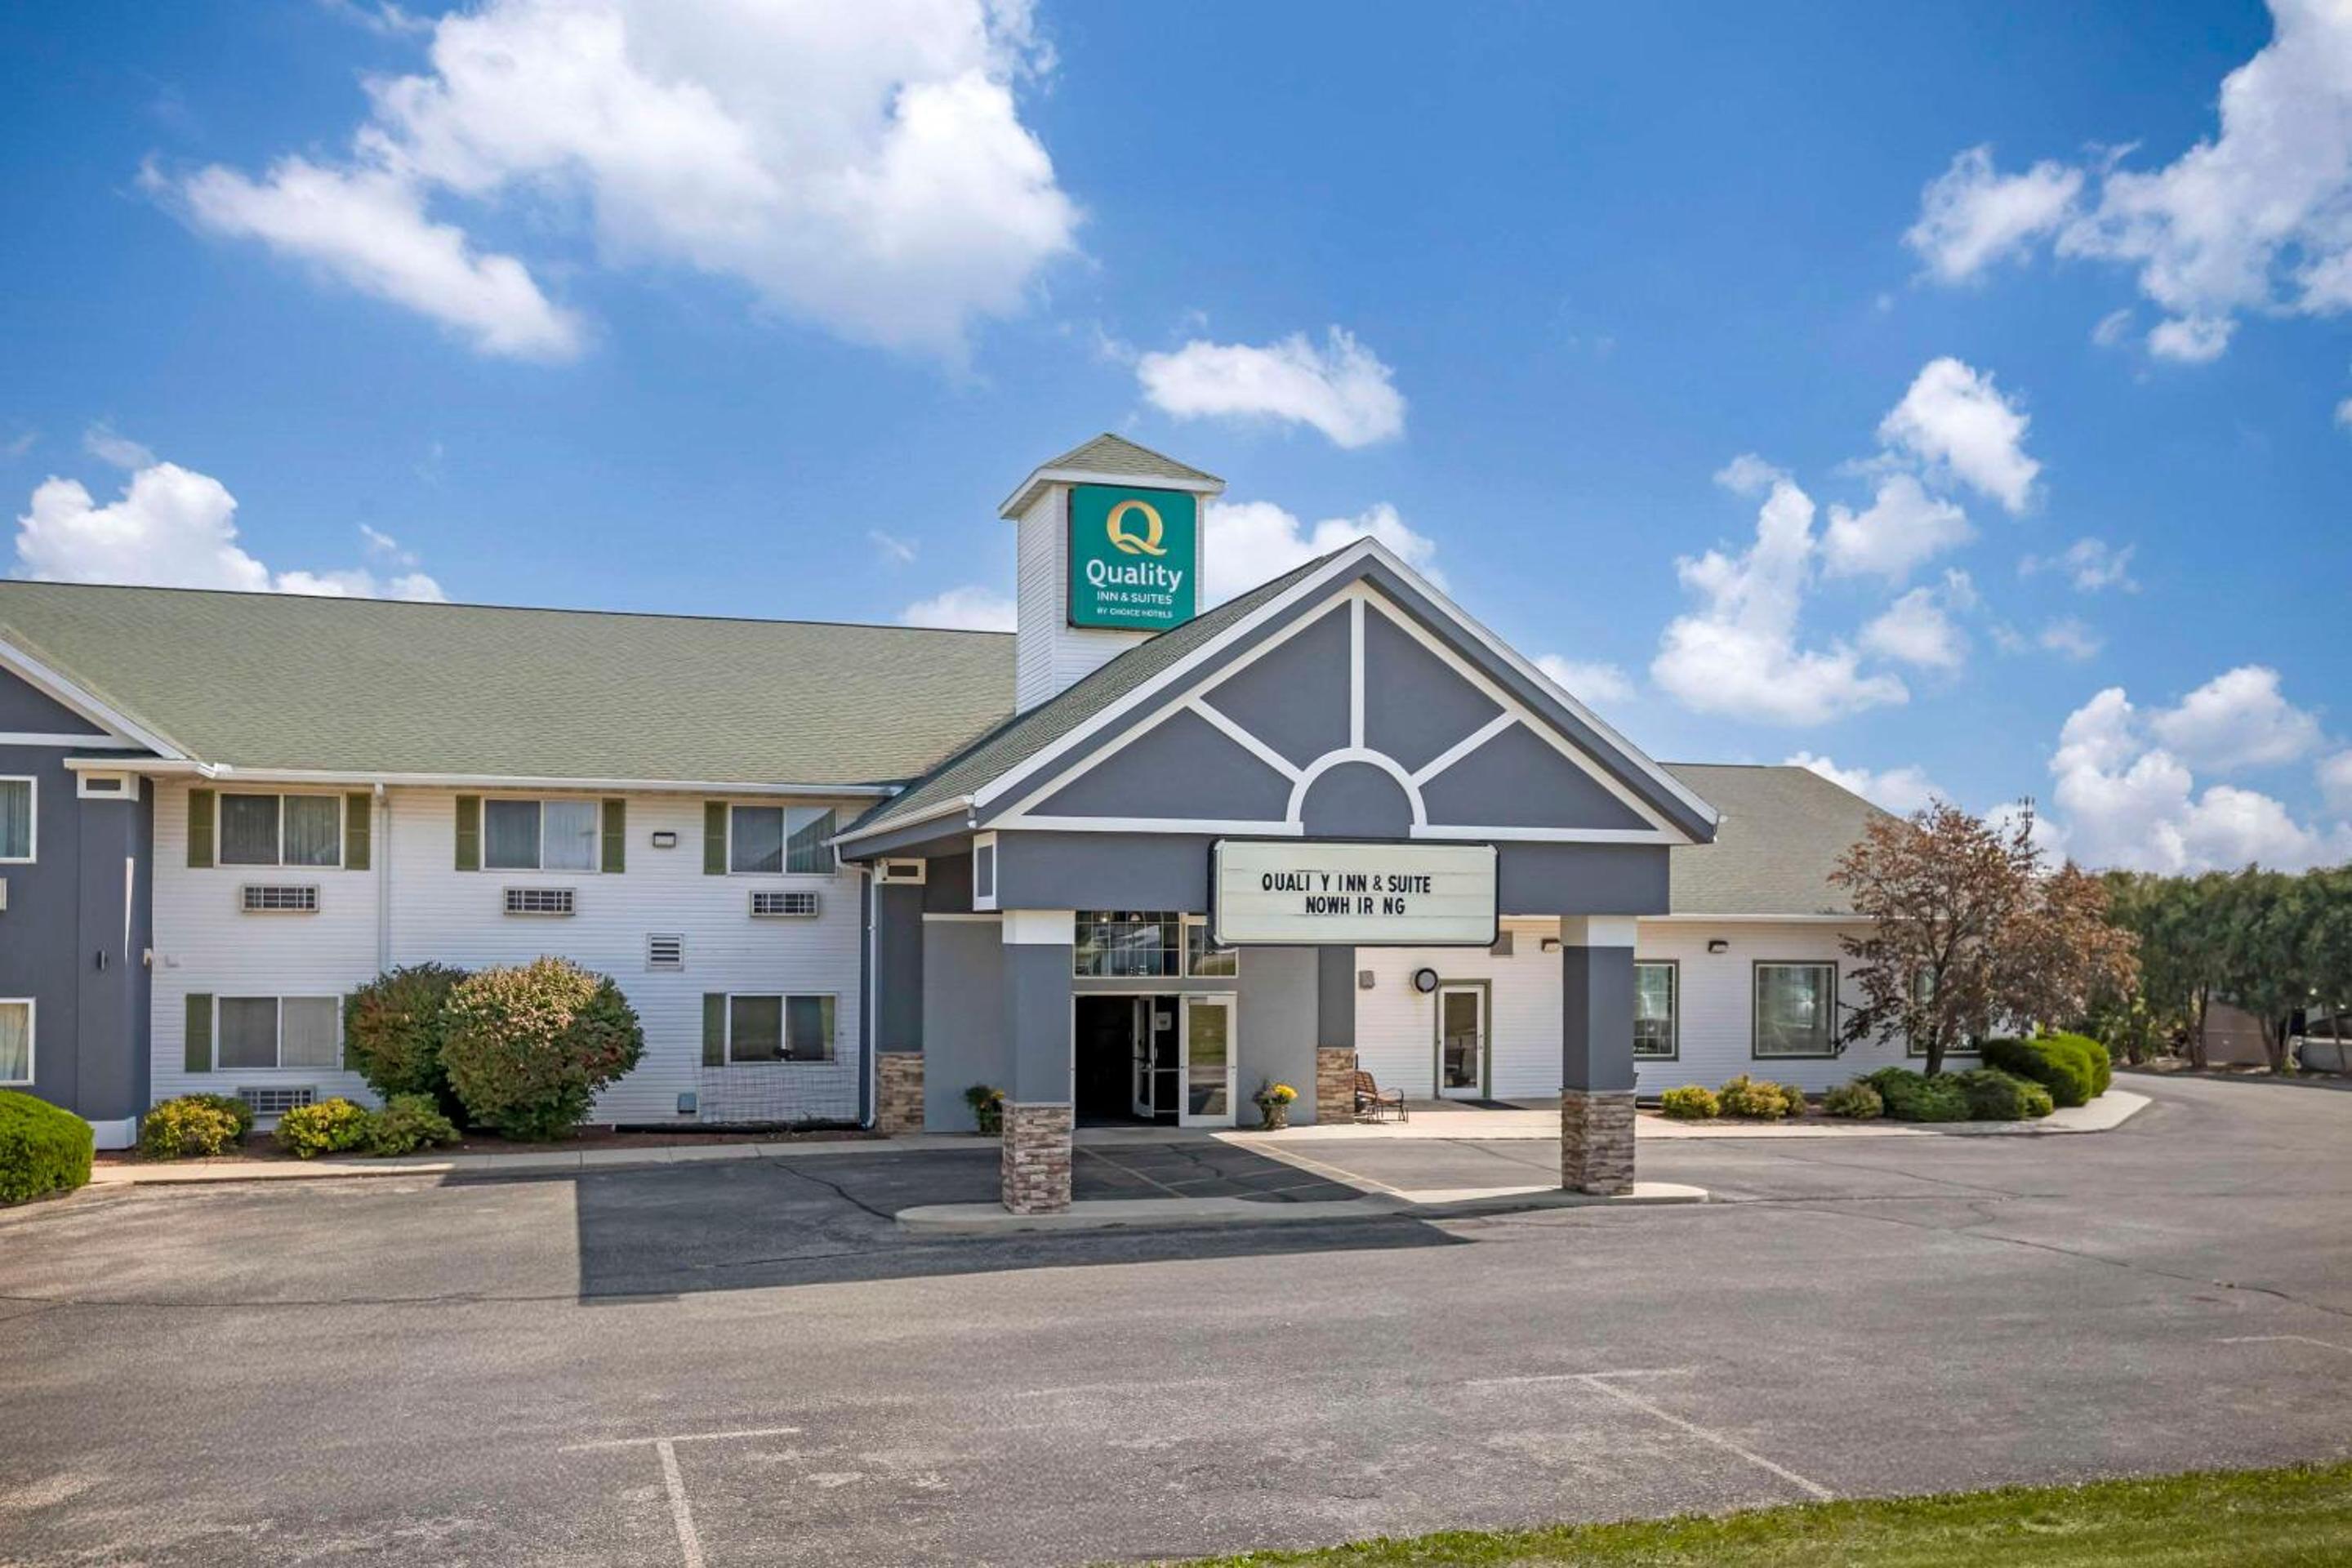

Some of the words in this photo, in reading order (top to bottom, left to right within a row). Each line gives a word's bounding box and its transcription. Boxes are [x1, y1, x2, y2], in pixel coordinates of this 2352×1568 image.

[1107, 500, 1167, 555] Q
[1086, 559, 1183, 593] Quality
[1097, 590, 1119, 602] INN
[1120, 592, 1129, 602] &
[1130, 593, 1173, 605] SUITES
[1097, 607, 1107, 616] BY
[1110, 608, 1141, 617] CHOICE
[1142, 609, 1174, 619] HOTELS
[1339, 874, 1367, 893] INN
[1373, 875, 1383, 892] &
[1388, 875, 1431, 893] SUITE
